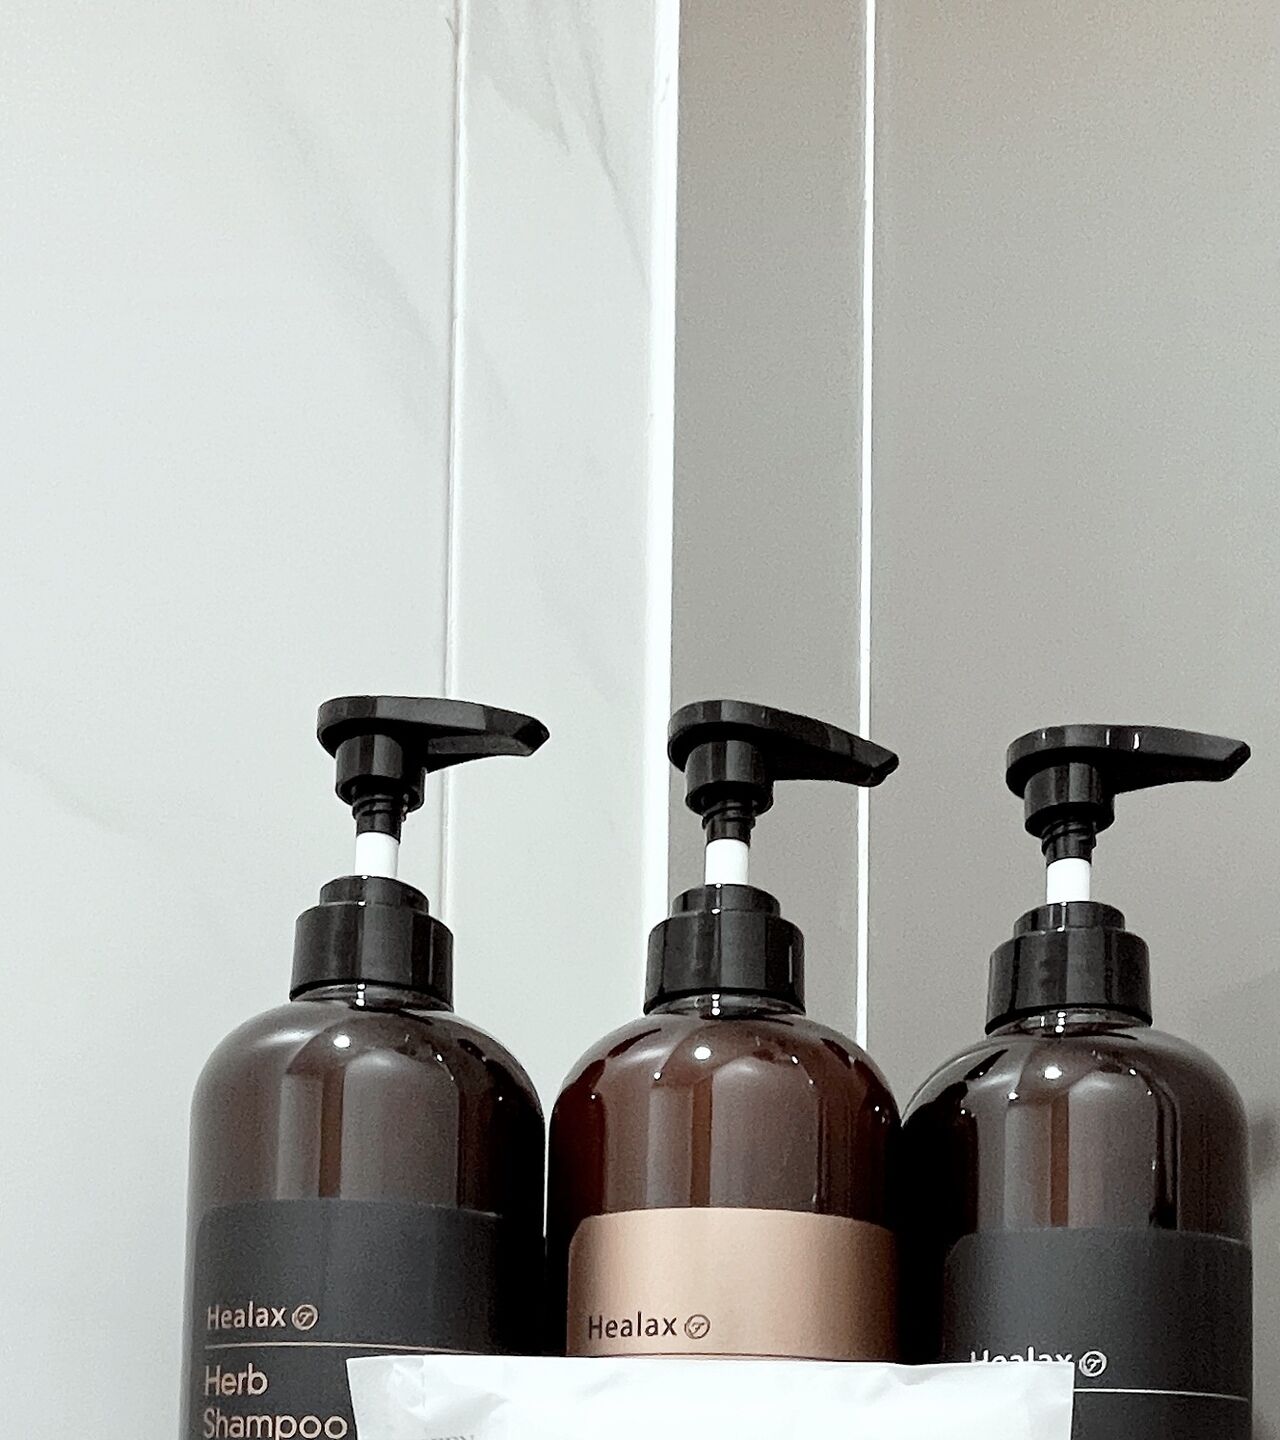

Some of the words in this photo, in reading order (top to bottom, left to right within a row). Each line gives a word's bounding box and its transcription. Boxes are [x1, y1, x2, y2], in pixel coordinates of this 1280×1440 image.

[206, 1301, 287, 1330] Healax
[588, 1311, 677, 1340] Healax
[204, 1363, 268, 1396] Herb
